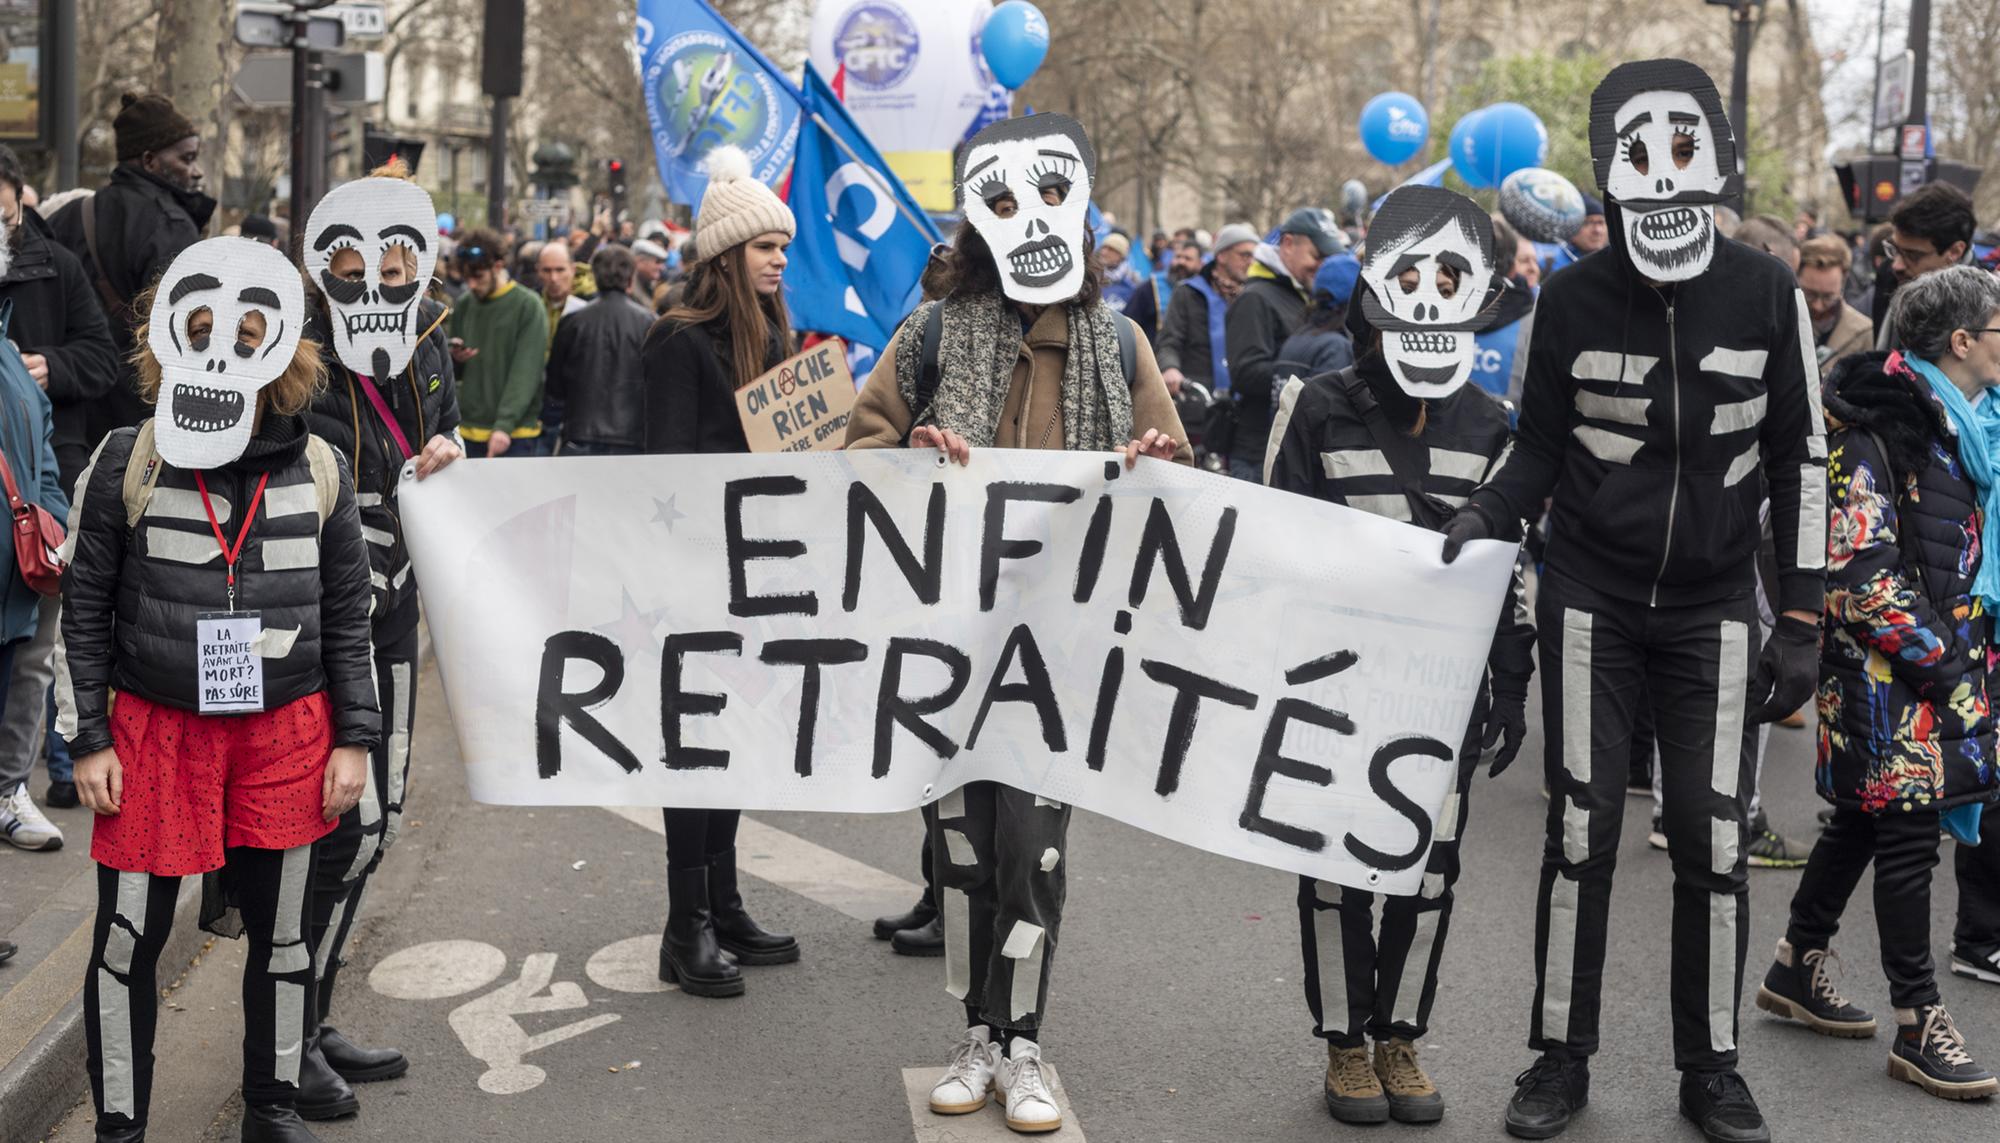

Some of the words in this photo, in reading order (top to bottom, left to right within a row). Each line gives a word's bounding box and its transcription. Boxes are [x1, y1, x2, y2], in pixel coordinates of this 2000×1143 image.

[843, 48, 906, 71] CFTC
[1473, 342, 1502, 373] tc
[747, 384, 769, 415] ON
[217, 628, 231, 640] LA
[202, 656, 232, 668] AVANT
[237, 654, 250, 664] LA
[230, 682, 259, 700] SÛRE
